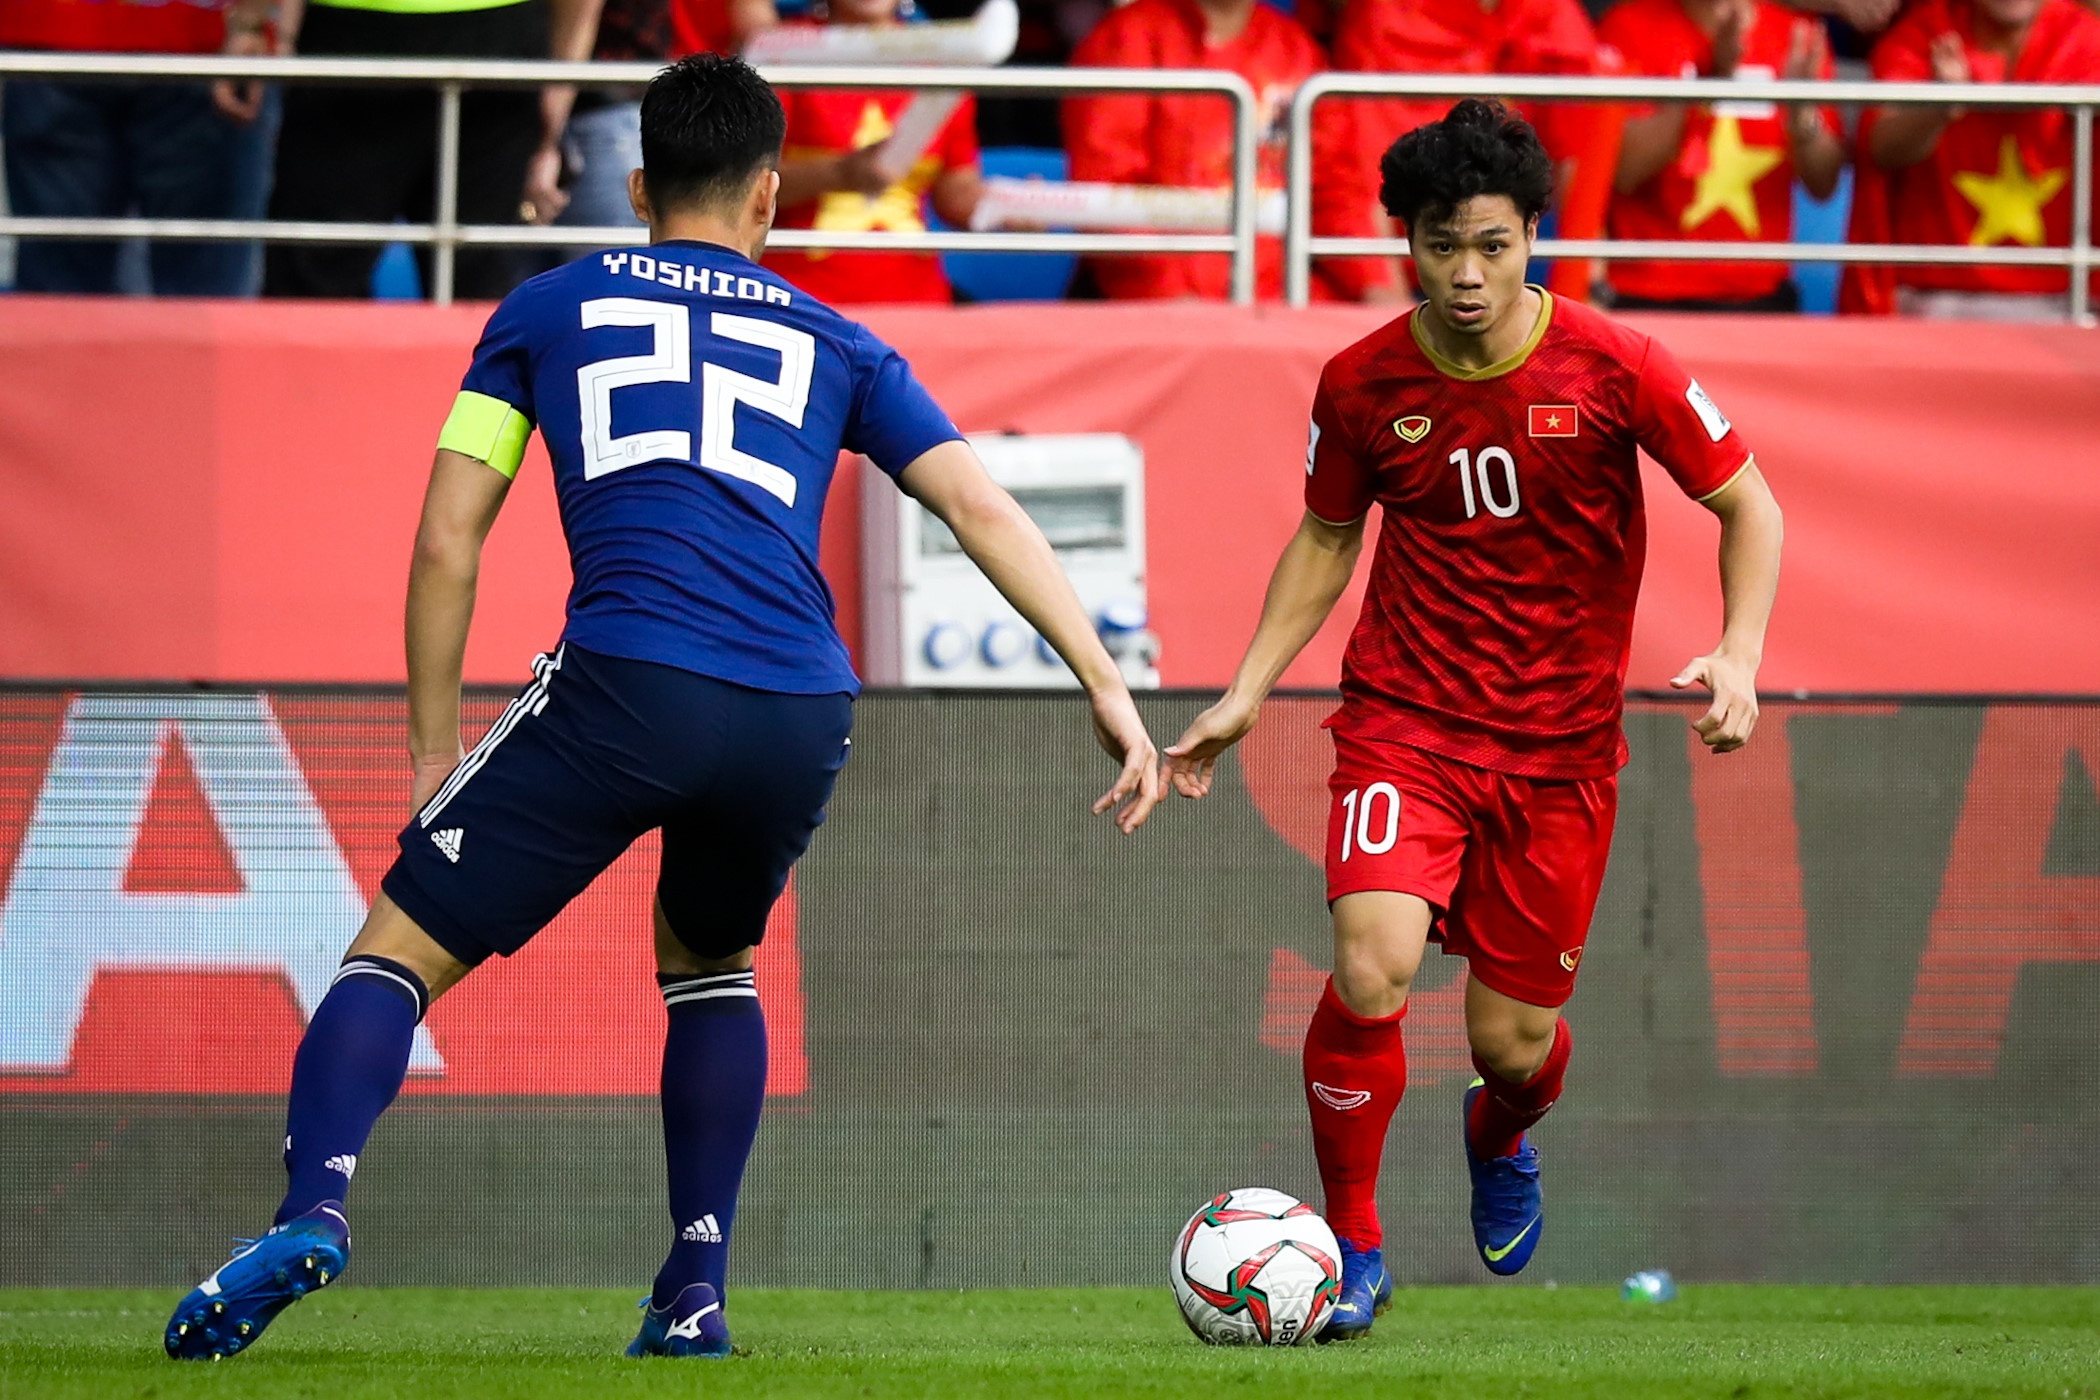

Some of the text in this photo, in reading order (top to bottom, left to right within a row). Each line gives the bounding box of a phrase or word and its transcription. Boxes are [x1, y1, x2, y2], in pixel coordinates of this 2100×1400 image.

[602, 252, 792, 307] YOSHIDA
[577, 297, 816, 509] 22
[1448, 446, 1520, 519] 10
[430, 831, 460, 863] adidas
[1341, 781, 1401, 863] 10
[324, 1159, 352, 1183] adid
[681, 1230, 723, 1244] adidas
